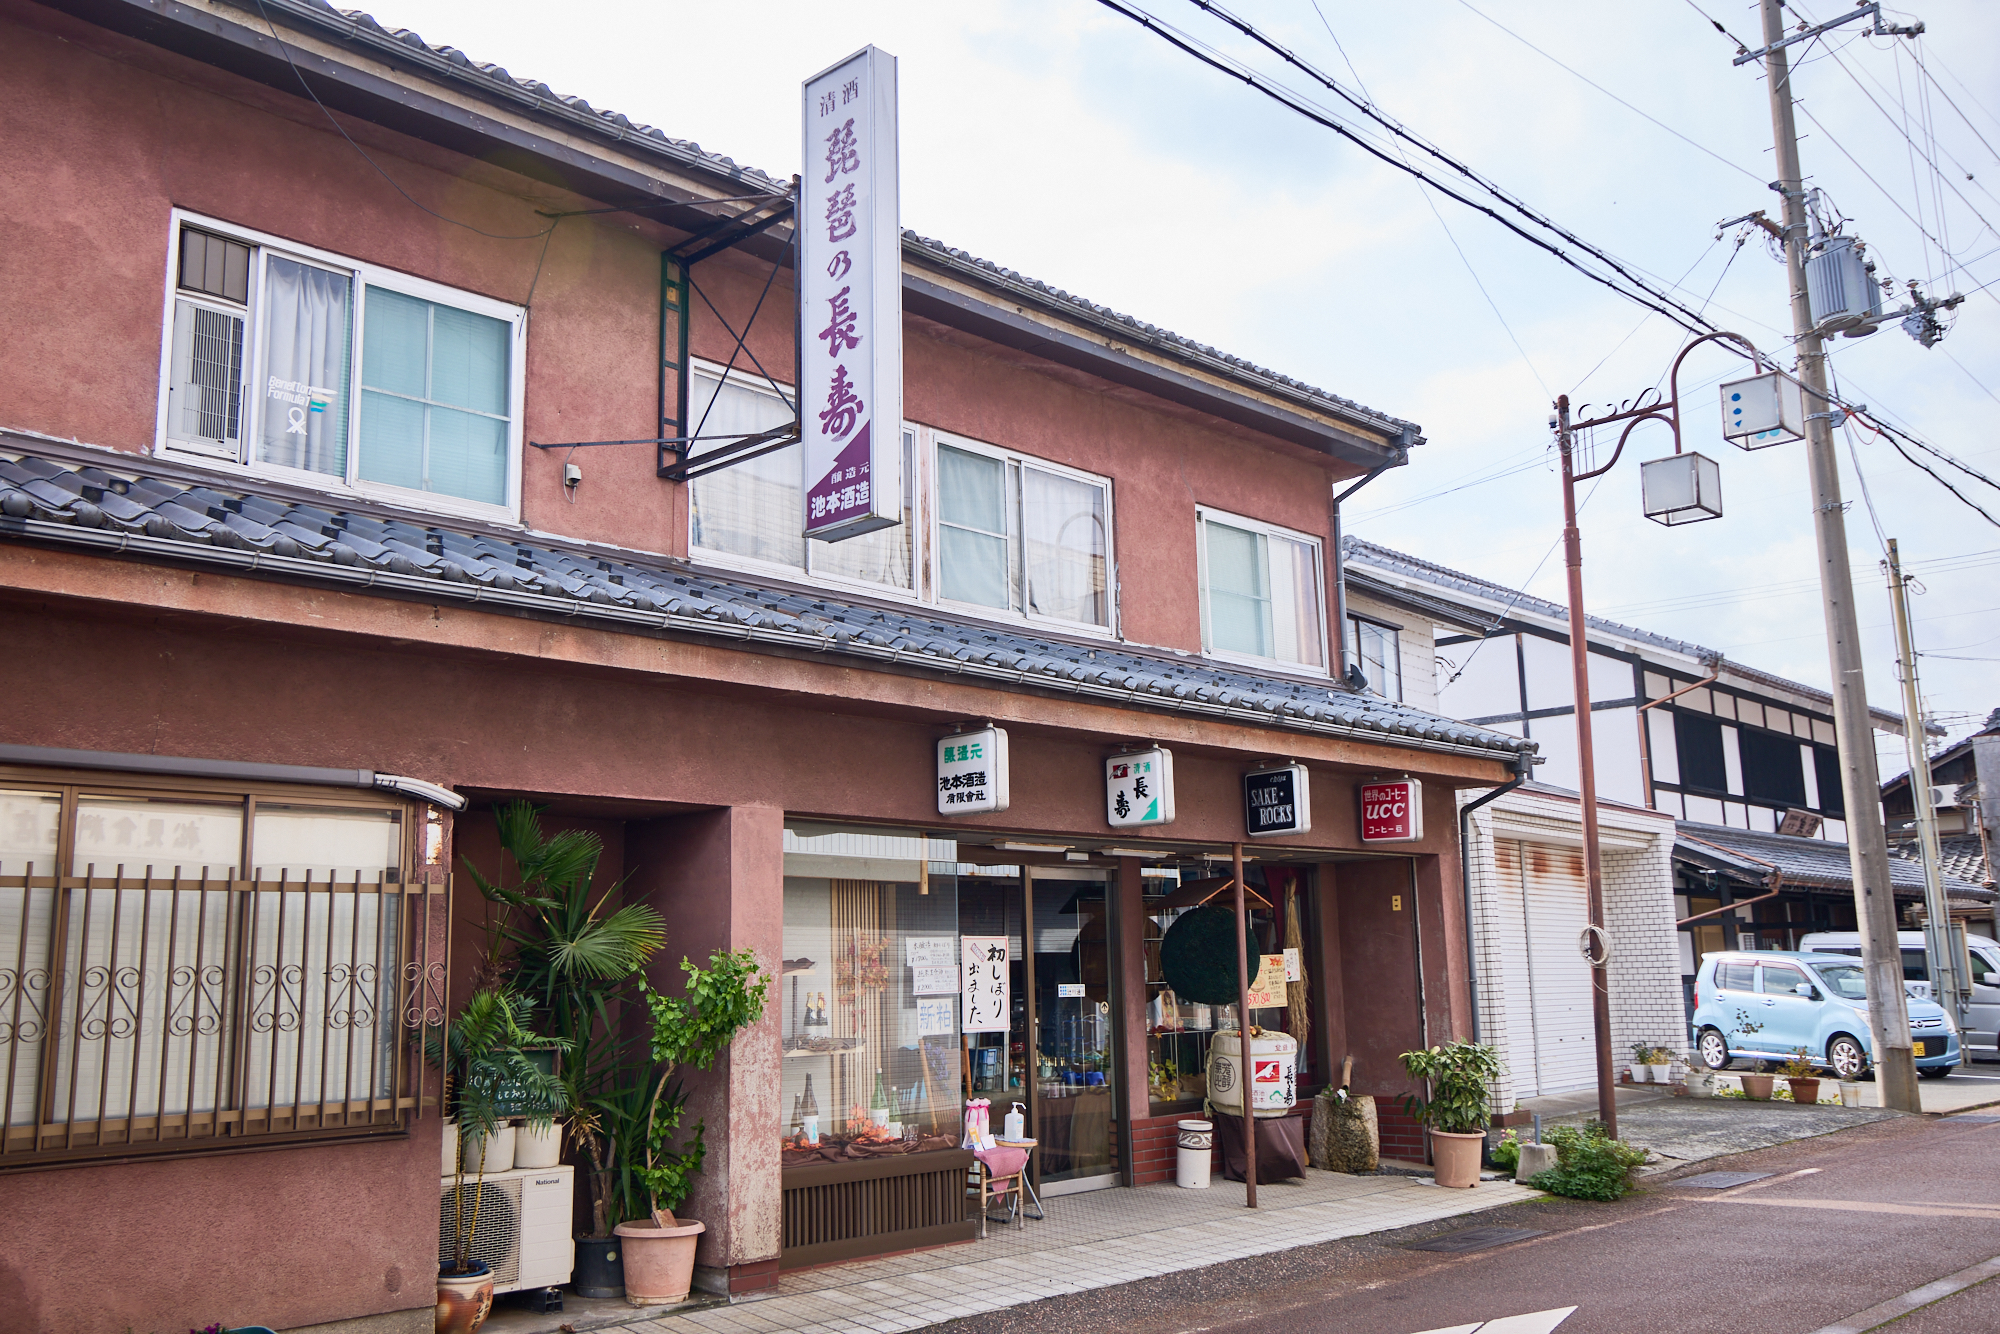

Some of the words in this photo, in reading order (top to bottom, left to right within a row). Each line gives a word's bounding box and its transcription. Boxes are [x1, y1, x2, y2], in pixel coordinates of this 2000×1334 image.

[820, 76, 860, 118] 清酒
[818, 116, 864, 443] 琵琶の長寿
[267, 386, 306, 406] Formula
[268, 375, 312, 396] Benetton
[811, 481, 870, 520] 池本酒造
[1133, 761, 1151, 775] 清酒
[939, 771, 988, 792] 池本酒造
[1364, 788, 1407, 802] 世界のコーヒー
[1259, 803, 1293, 826] ROCKS
[1368, 824, 1404, 835] コーヒー豆
[987, 943, 1006, 1019] 初しぼり
[968, 962, 983, 1024] 出ました
[535, 1178, 560, 1186] National
